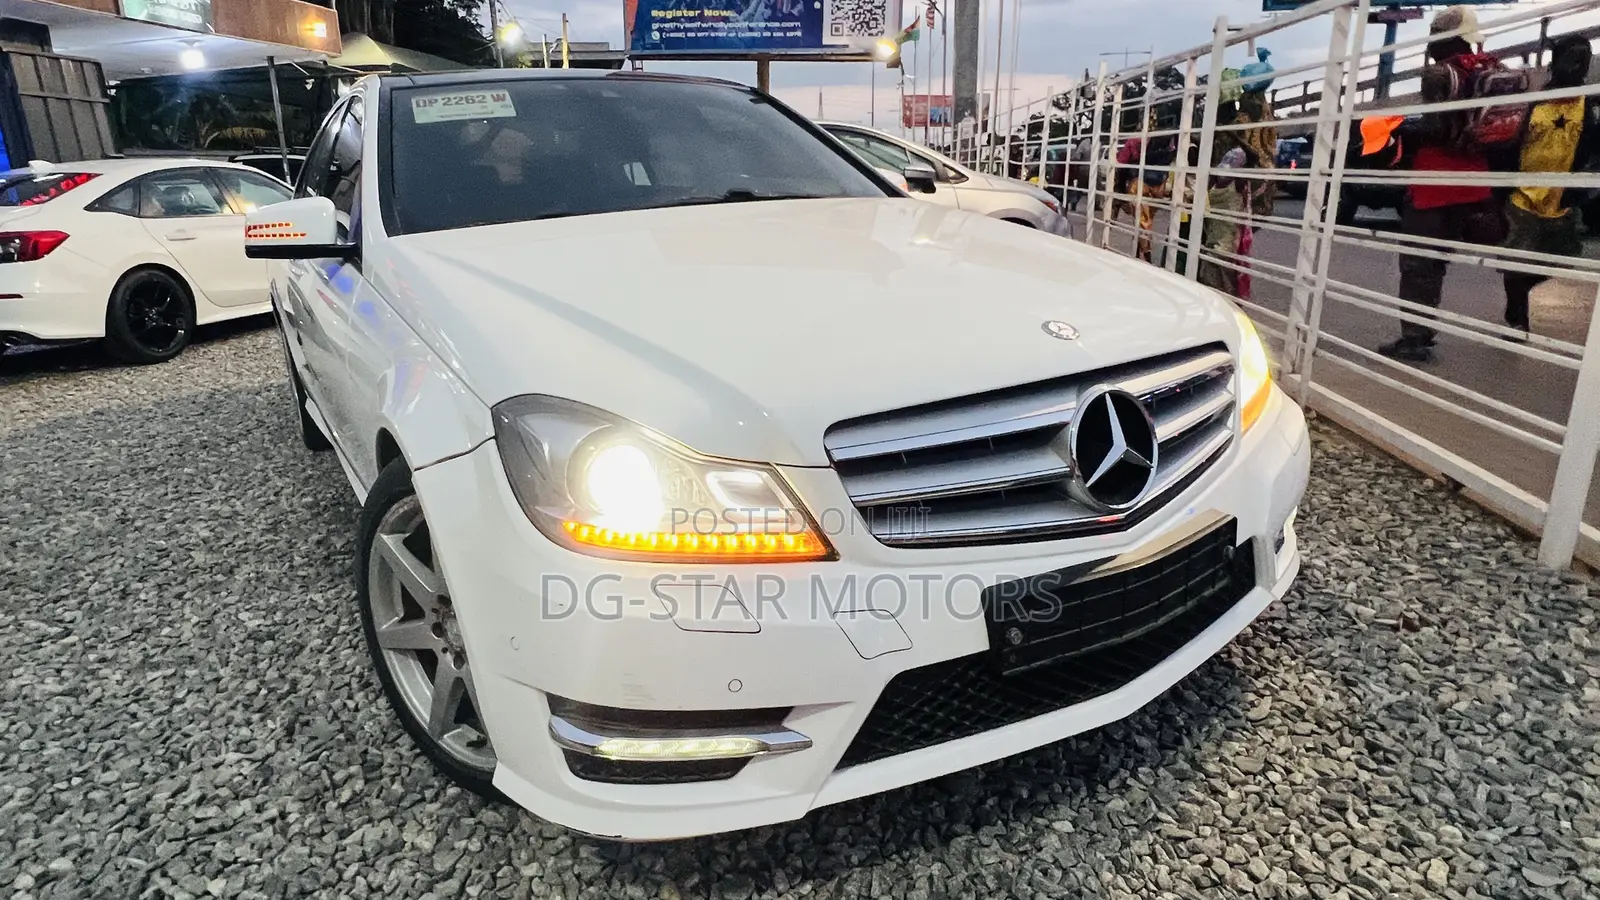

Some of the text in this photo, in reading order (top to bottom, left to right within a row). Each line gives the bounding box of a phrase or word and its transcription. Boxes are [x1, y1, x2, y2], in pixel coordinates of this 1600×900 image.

[651, 9, 701, 19] Register
[651, 21, 801, 30] givethyselfwhollyconference.com
[441, 94, 488, 106] 2262
[491, 93, 507, 103] W
